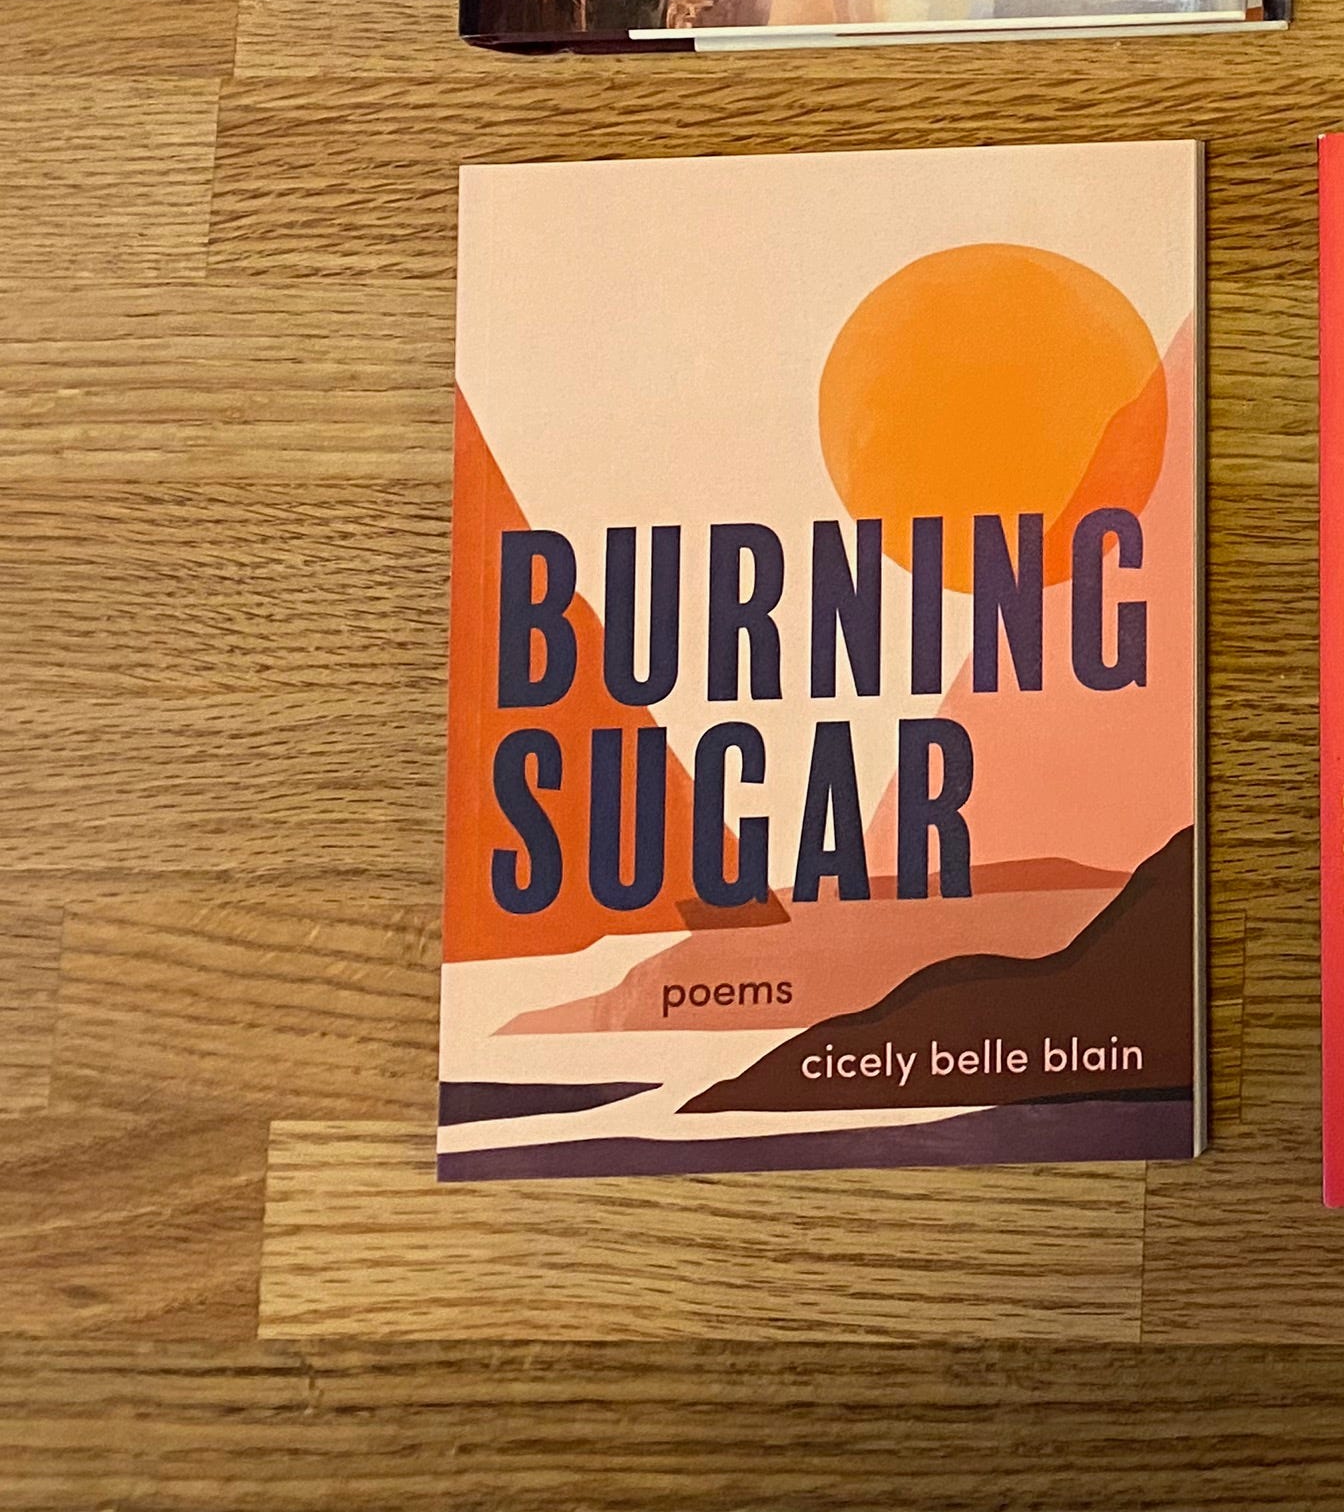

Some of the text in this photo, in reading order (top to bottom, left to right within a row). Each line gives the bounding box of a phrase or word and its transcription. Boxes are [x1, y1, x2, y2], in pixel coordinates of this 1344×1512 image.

[496, 507, 1148, 708] BURNING
[490, 718, 976, 915] SUGAR
[662, 978, 793, 1017] poems
[801, 1037, 1144, 1086] cicely belle blain
